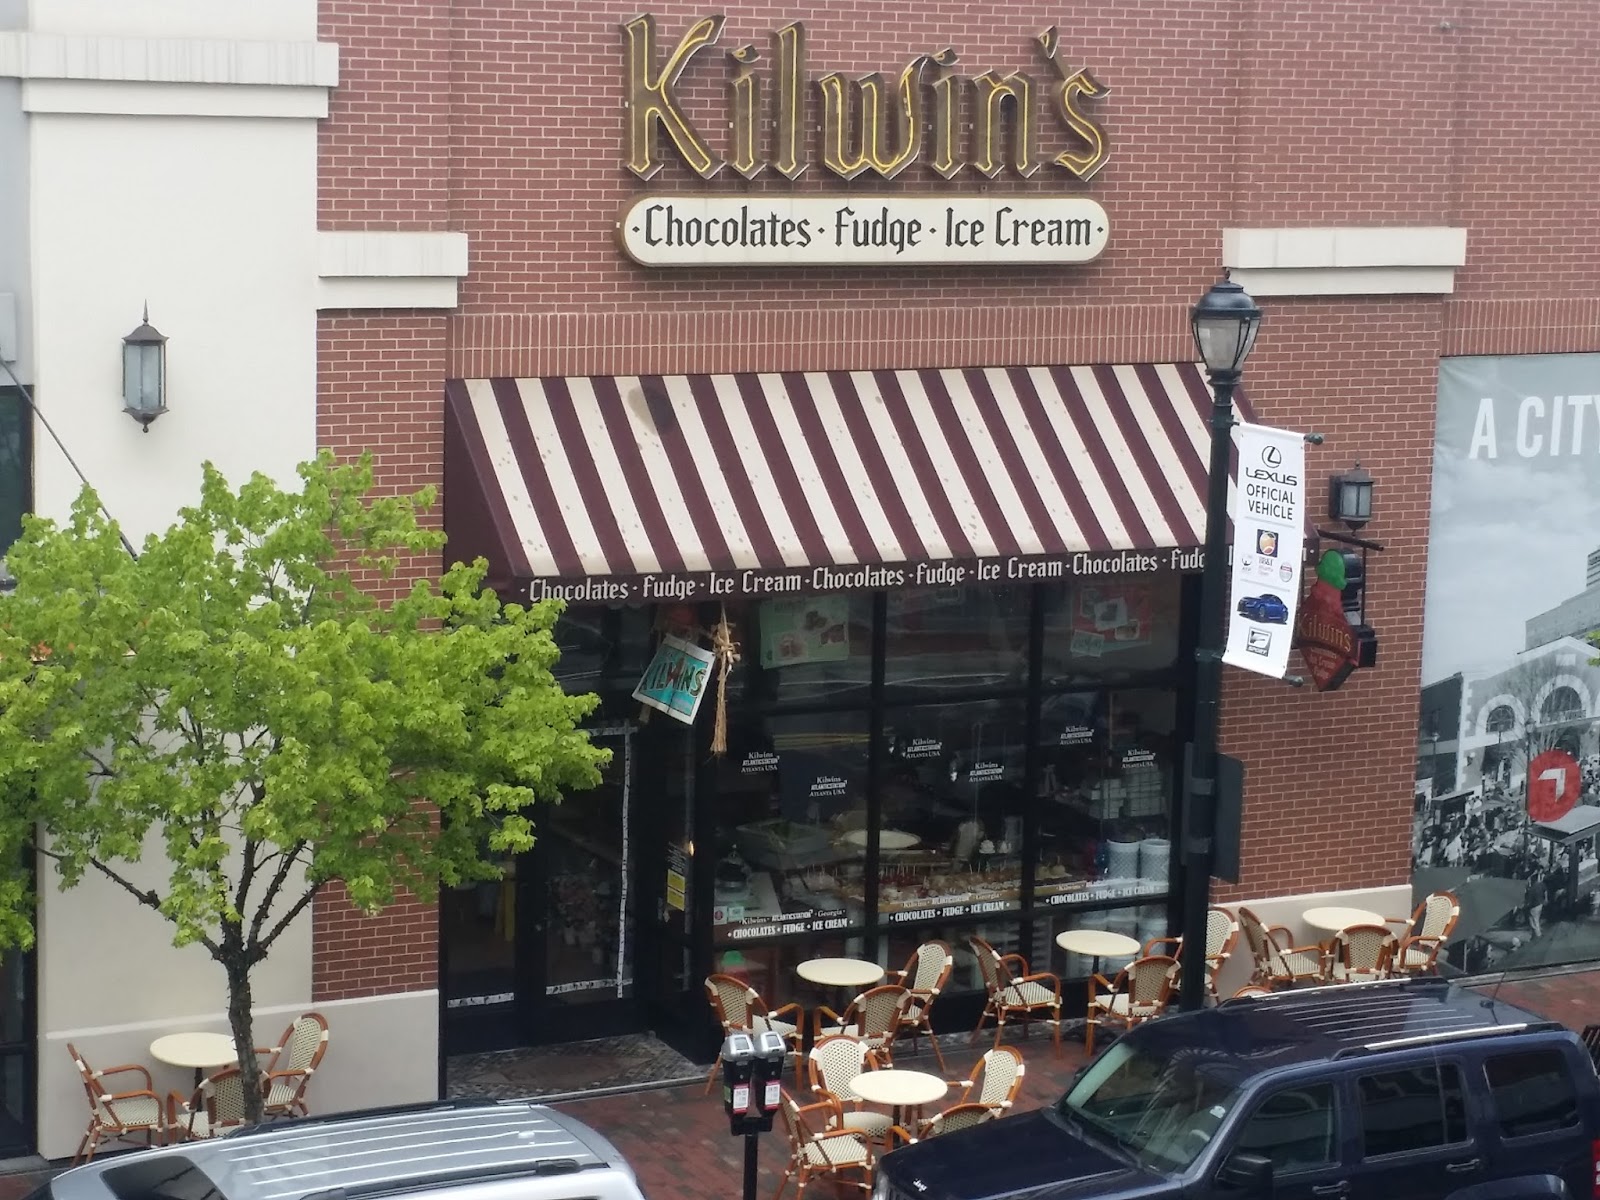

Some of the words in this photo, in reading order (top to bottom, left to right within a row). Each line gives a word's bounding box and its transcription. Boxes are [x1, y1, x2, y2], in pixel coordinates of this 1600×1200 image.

[622, 13, 1111, 181] Kilwin's
[645, 204, 812, 247] Chocolates
[835, 206, 922, 255] Fudge
[945, 206, 985, 247] Ice
[995, 206, 1092, 247] Cream
[1468, 398, 1498, 459] A
[1245, 467, 1298, 487] LEXUS
[1246, 483, 1296, 505] OFFICIAL
[1247, 499, 1293, 521] VEHICLE
[529, 578, 629, 602] Chocolates
[643, 574, 696, 600] Fudge
[709, 572, 735, 594] Ice
[742, 570, 801, 593] Cream
[812, 564, 905, 590] Chocolates
[916, 561, 965, 587] Fudge
[977, 559, 1001, 581] Ice
[1007, 556, 1062, 579] Cream
[1072, 551, 1158, 576] Chocolates
[748, 751, 773, 759] Kilwins
[1050, 891, 1089, 905] CHOCOLATES
[1095, 889, 1116, 900] FUDGE
[1122, 887, 1132, 896] ICE
[817, 909, 843, 918] Georgia
[894, 909, 936, 922] CHOCOLATES
[942, 906, 964, 917] FUDGE
[970, 903, 981, 914] ICE
[982, 901, 1005, 912] CREAM
[733, 925, 776, 939] CHOCOLATES
[782, 922, 805, 934] FUDGE
[812, 921, 823, 931] ICE
[824, 918, 848, 929] CREAM
